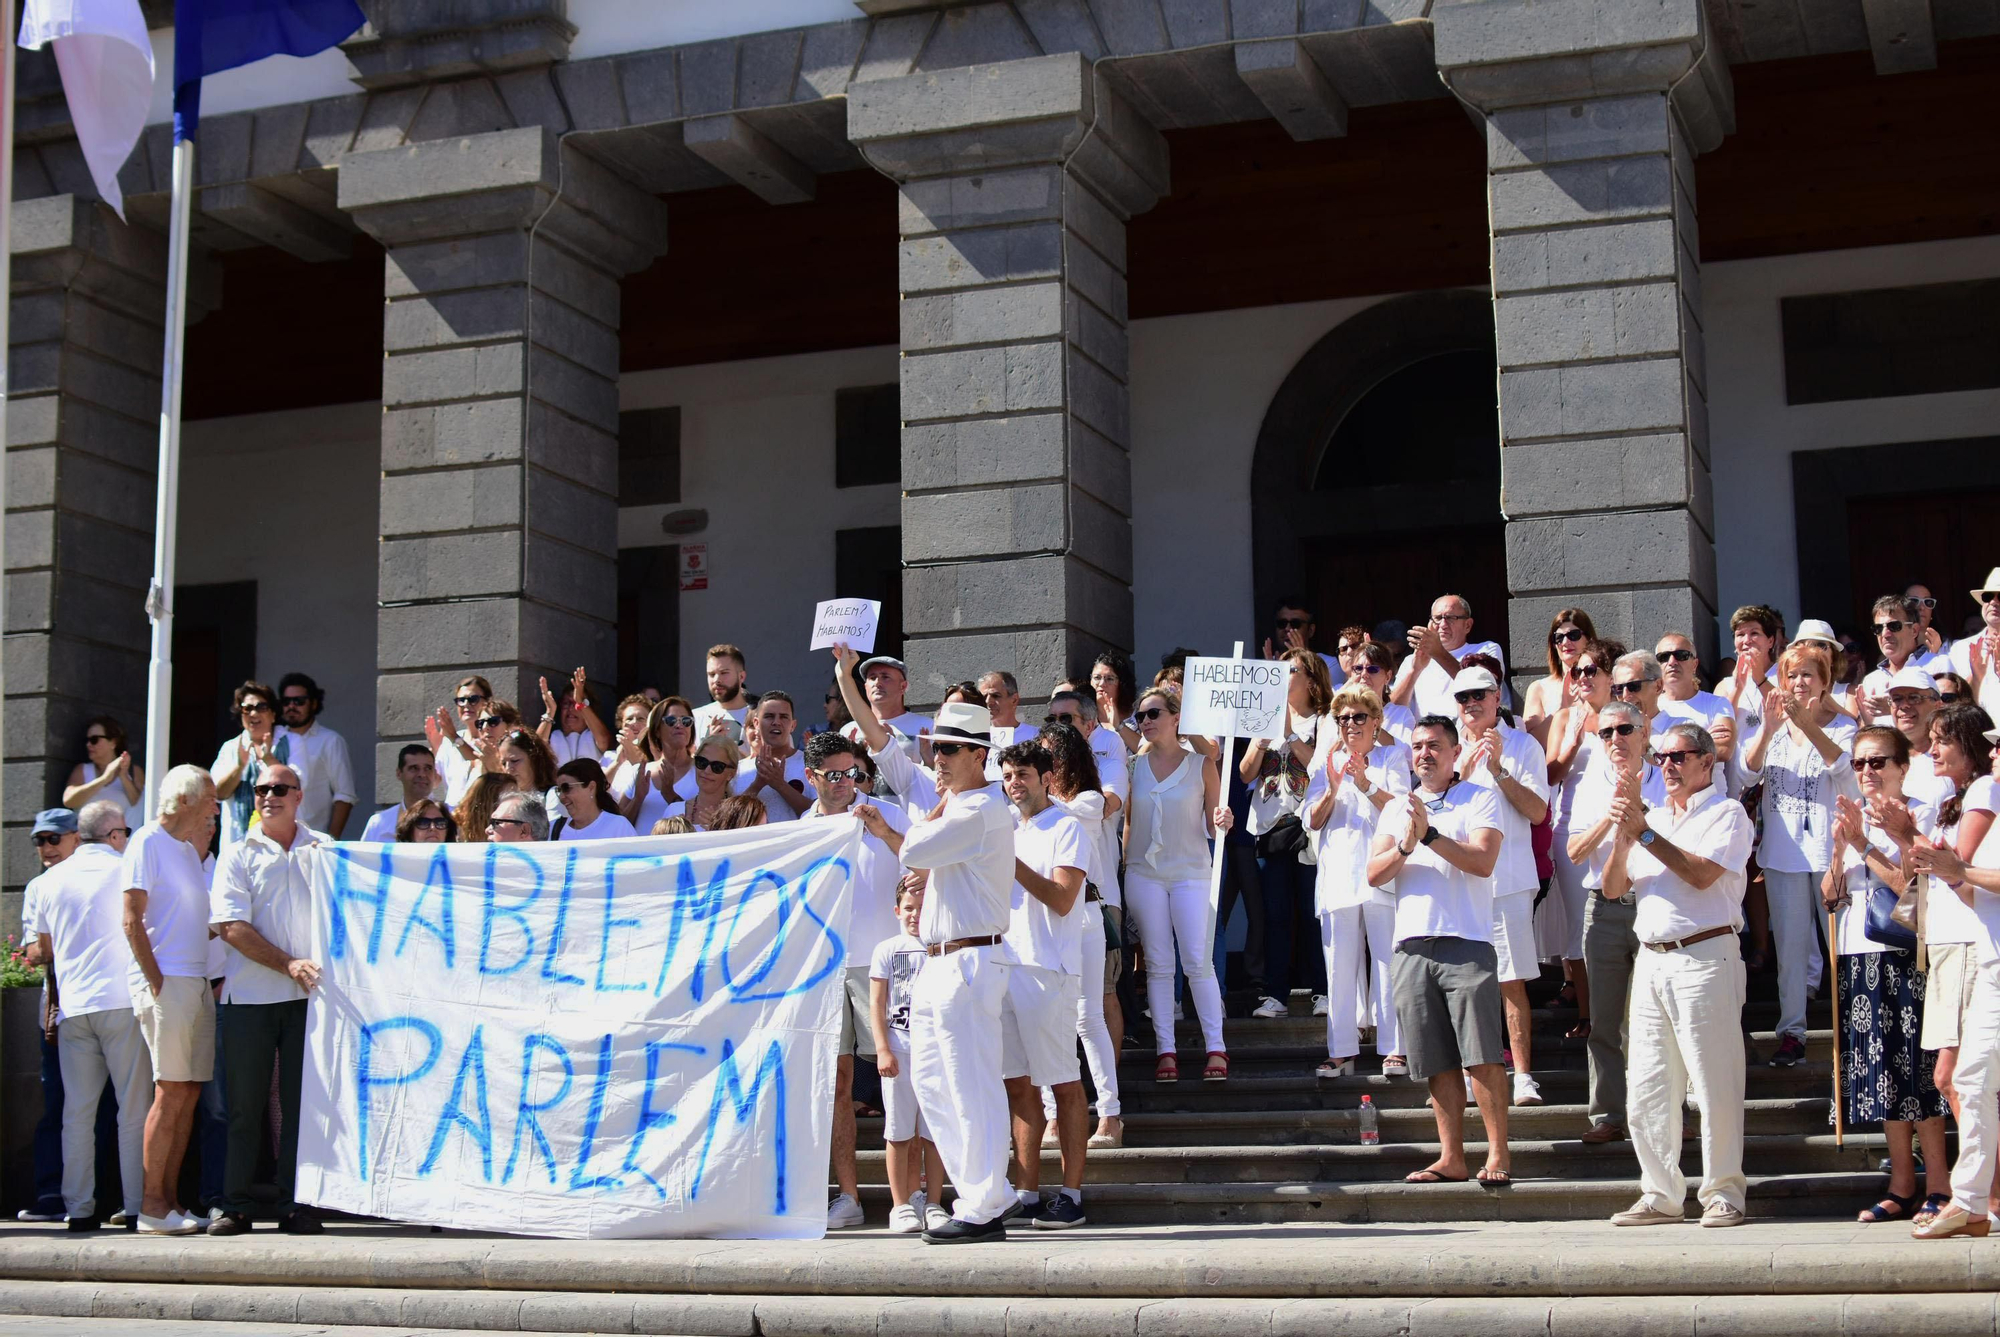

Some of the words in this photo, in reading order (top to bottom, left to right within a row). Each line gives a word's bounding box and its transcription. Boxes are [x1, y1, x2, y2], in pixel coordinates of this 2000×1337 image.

[823, 603, 868, 618] PARLEM?
[816, 622, 871, 638] HABLAMOS?
[1193, 664, 1281, 686] HABLEMOS
[1209, 689, 1263, 711] PARLEM
[328, 841, 852, 1004] HABLEMOS
[355, 1016, 789, 1217] PARLEM
